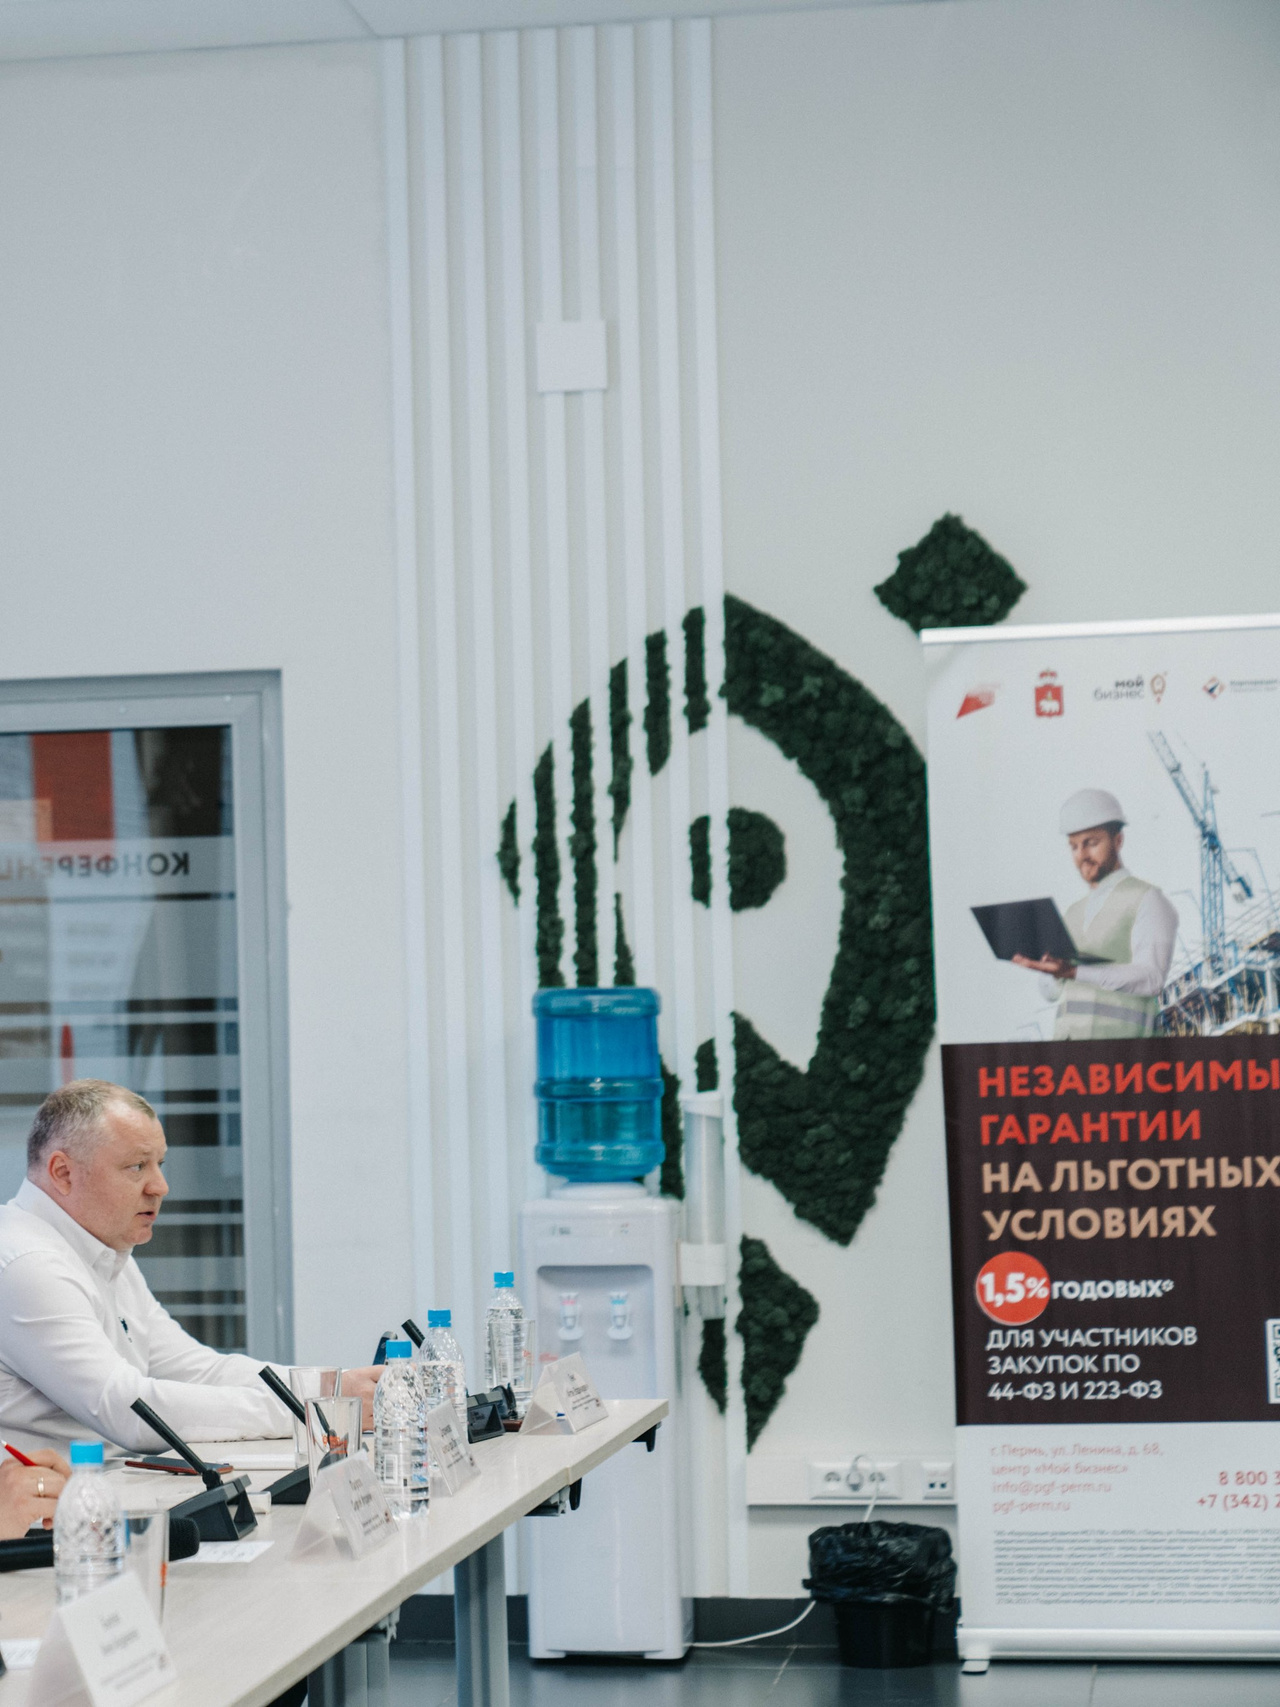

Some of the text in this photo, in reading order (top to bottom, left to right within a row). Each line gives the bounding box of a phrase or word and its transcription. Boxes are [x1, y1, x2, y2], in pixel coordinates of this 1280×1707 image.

[979, 1058, 1280, 1098] НЕЗАВИСИМЫ
[980, 1109, 1201, 1145] ГАРАНТИИ
[982, 1156, 1280, 1193] НА ЛЬГОТНЫХ
[982, 1205, 1217, 1241] УСЛОВИЯХ
[979, 1272, 1050, 1307] 1,5%
[985, 1326, 1198, 1351] ДЛЯ УЧАСТНИКОВ
[987, 1353, 1140, 1375] ЗАКУПОК ПО
[987, 1379, 1163, 1401] 44-ФЗ И 223-ФЗ
[991, 1465, 1031, 1477] центр
[1219, 1471, 1228, 1485] 8
[1235, 1471, 1267, 1485] 800
[1198, 1494, 1217, 1508] +7
[1223, 1494, 1268, 1511] (342)
